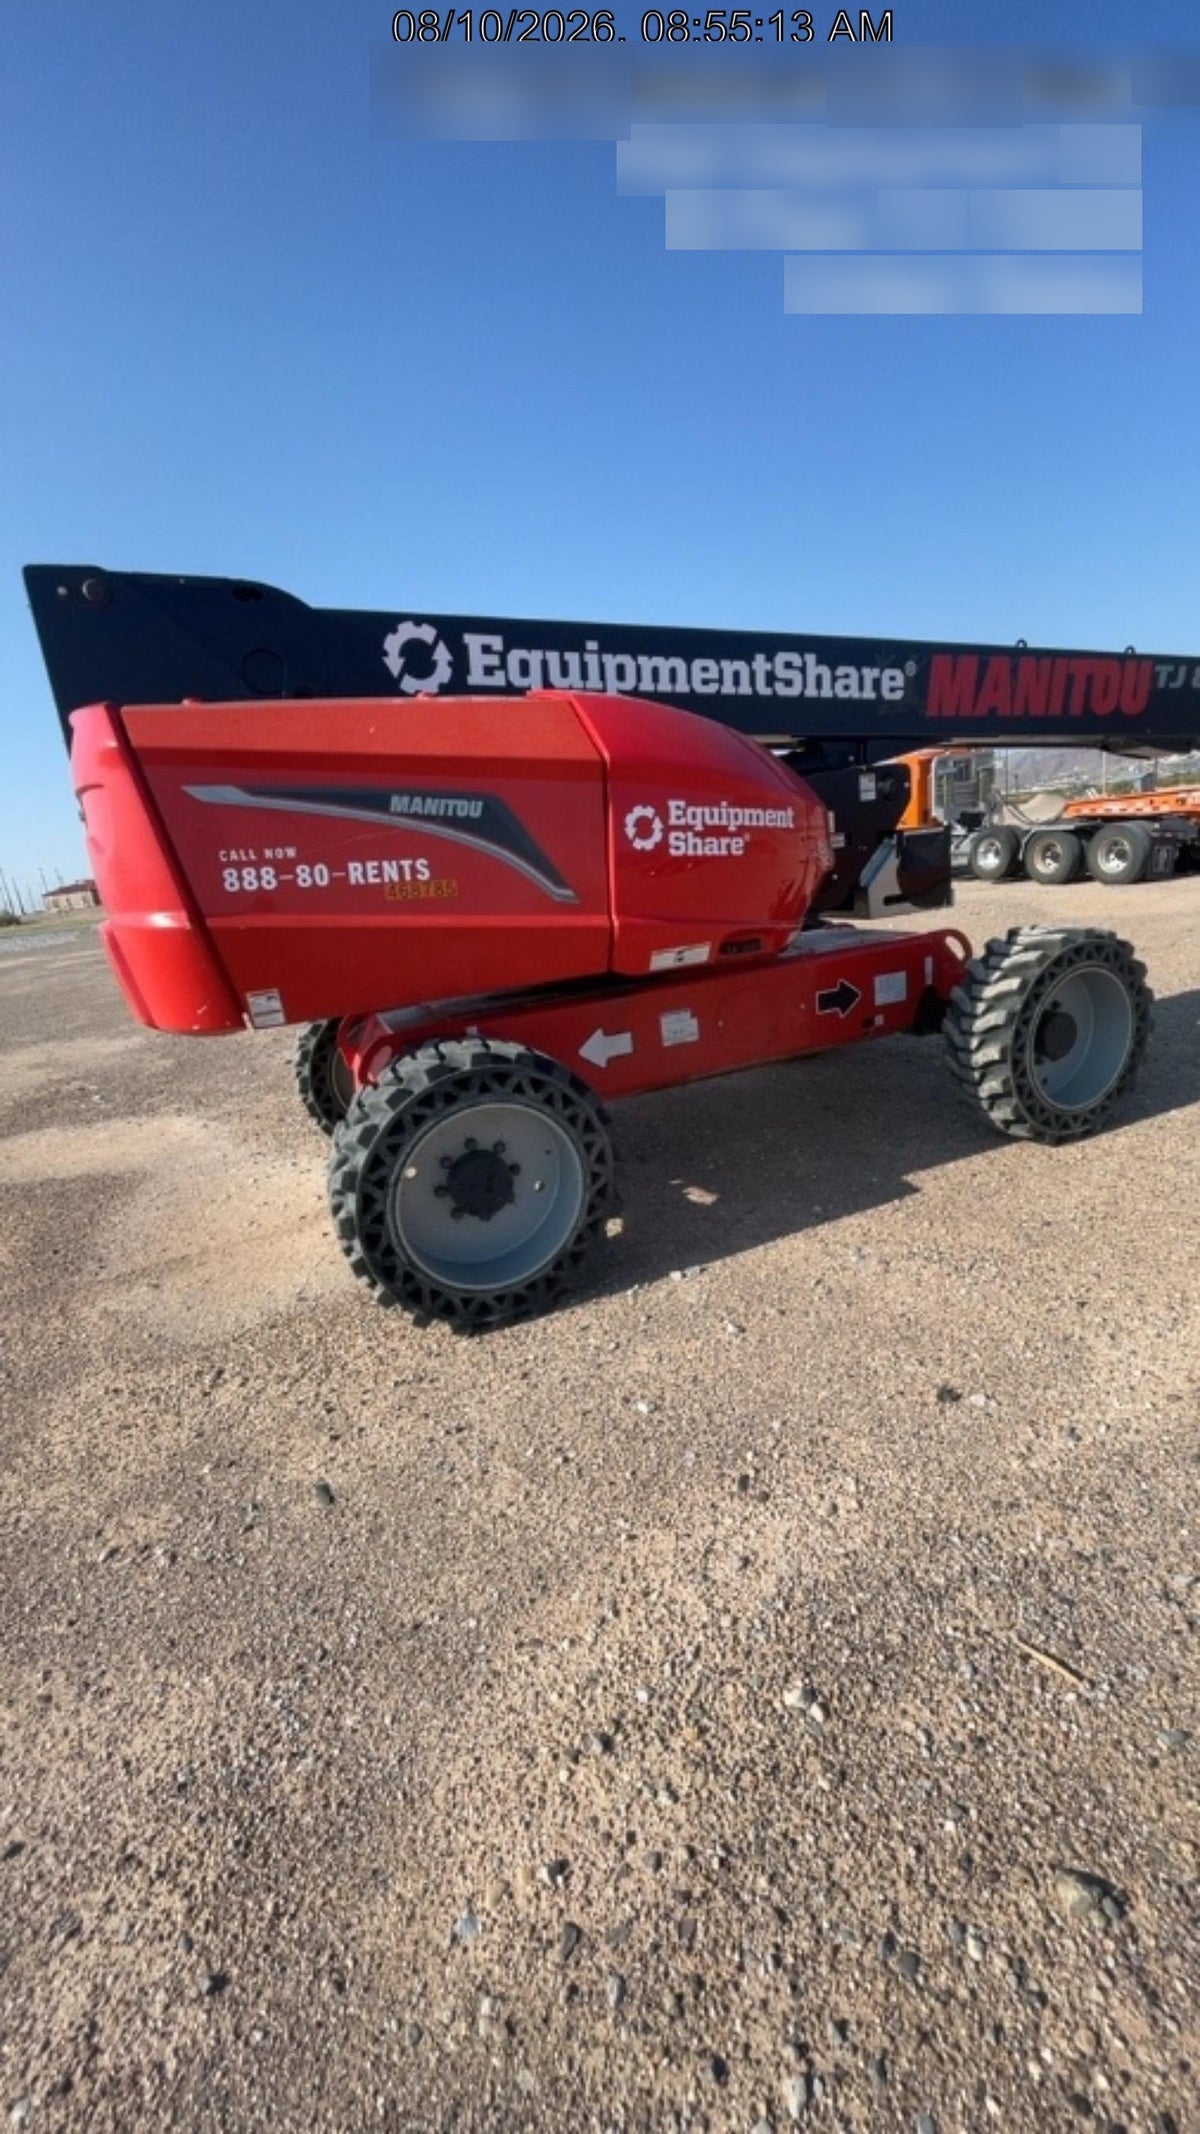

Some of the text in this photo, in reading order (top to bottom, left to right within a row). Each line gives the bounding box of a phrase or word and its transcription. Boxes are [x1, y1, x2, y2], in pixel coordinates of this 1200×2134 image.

[925, 653, 1154, 717] MANITOU
[1155, 665, 1188, 689] TJ
[390, 795, 484, 818] MANITOU
[667, 800, 795, 832] Equipment
[219, 847, 298, 862] CALL NOW
[222, 857, 431, 892] 888-80-RENTS
